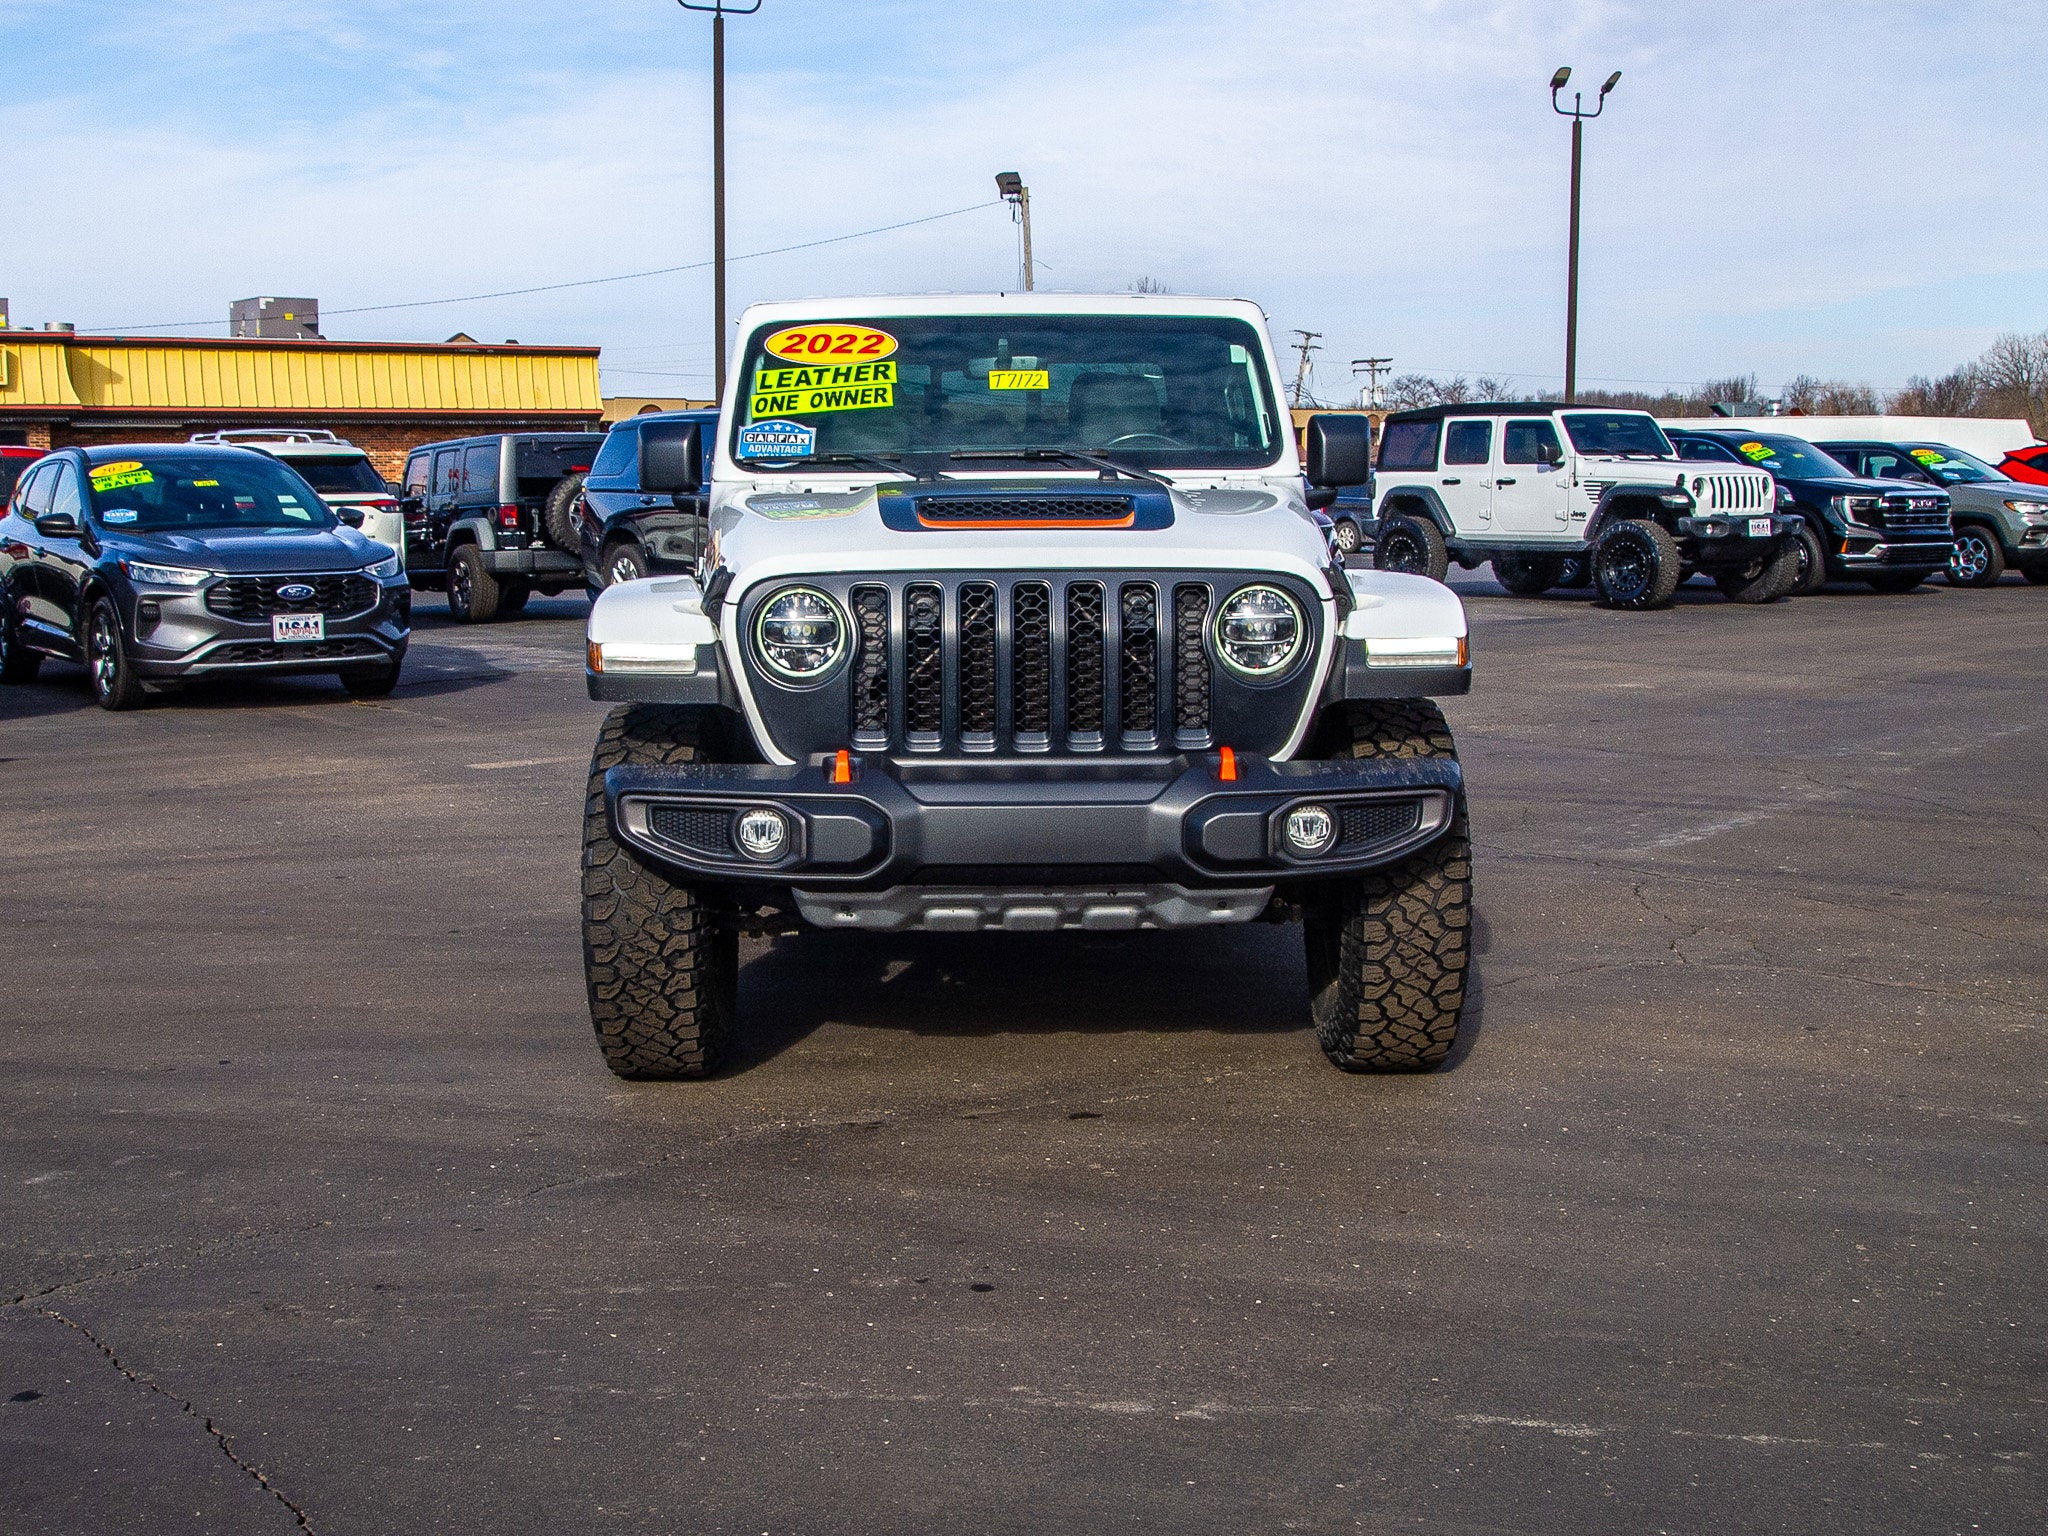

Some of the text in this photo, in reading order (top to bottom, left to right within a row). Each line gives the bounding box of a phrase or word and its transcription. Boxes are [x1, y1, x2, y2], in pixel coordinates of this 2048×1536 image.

[779, 333, 885, 354] 2022
[759, 363, 891, 390] LEATHER
[754, 387, 888, 414] ONE OWNER
[744, 433, 810, 445] CARFAX
[747, 444, 803, 454] ADVANTAGE
[95, 471, 149, 484] ONE OWNER
[104, 477, 143, 488] SALE
